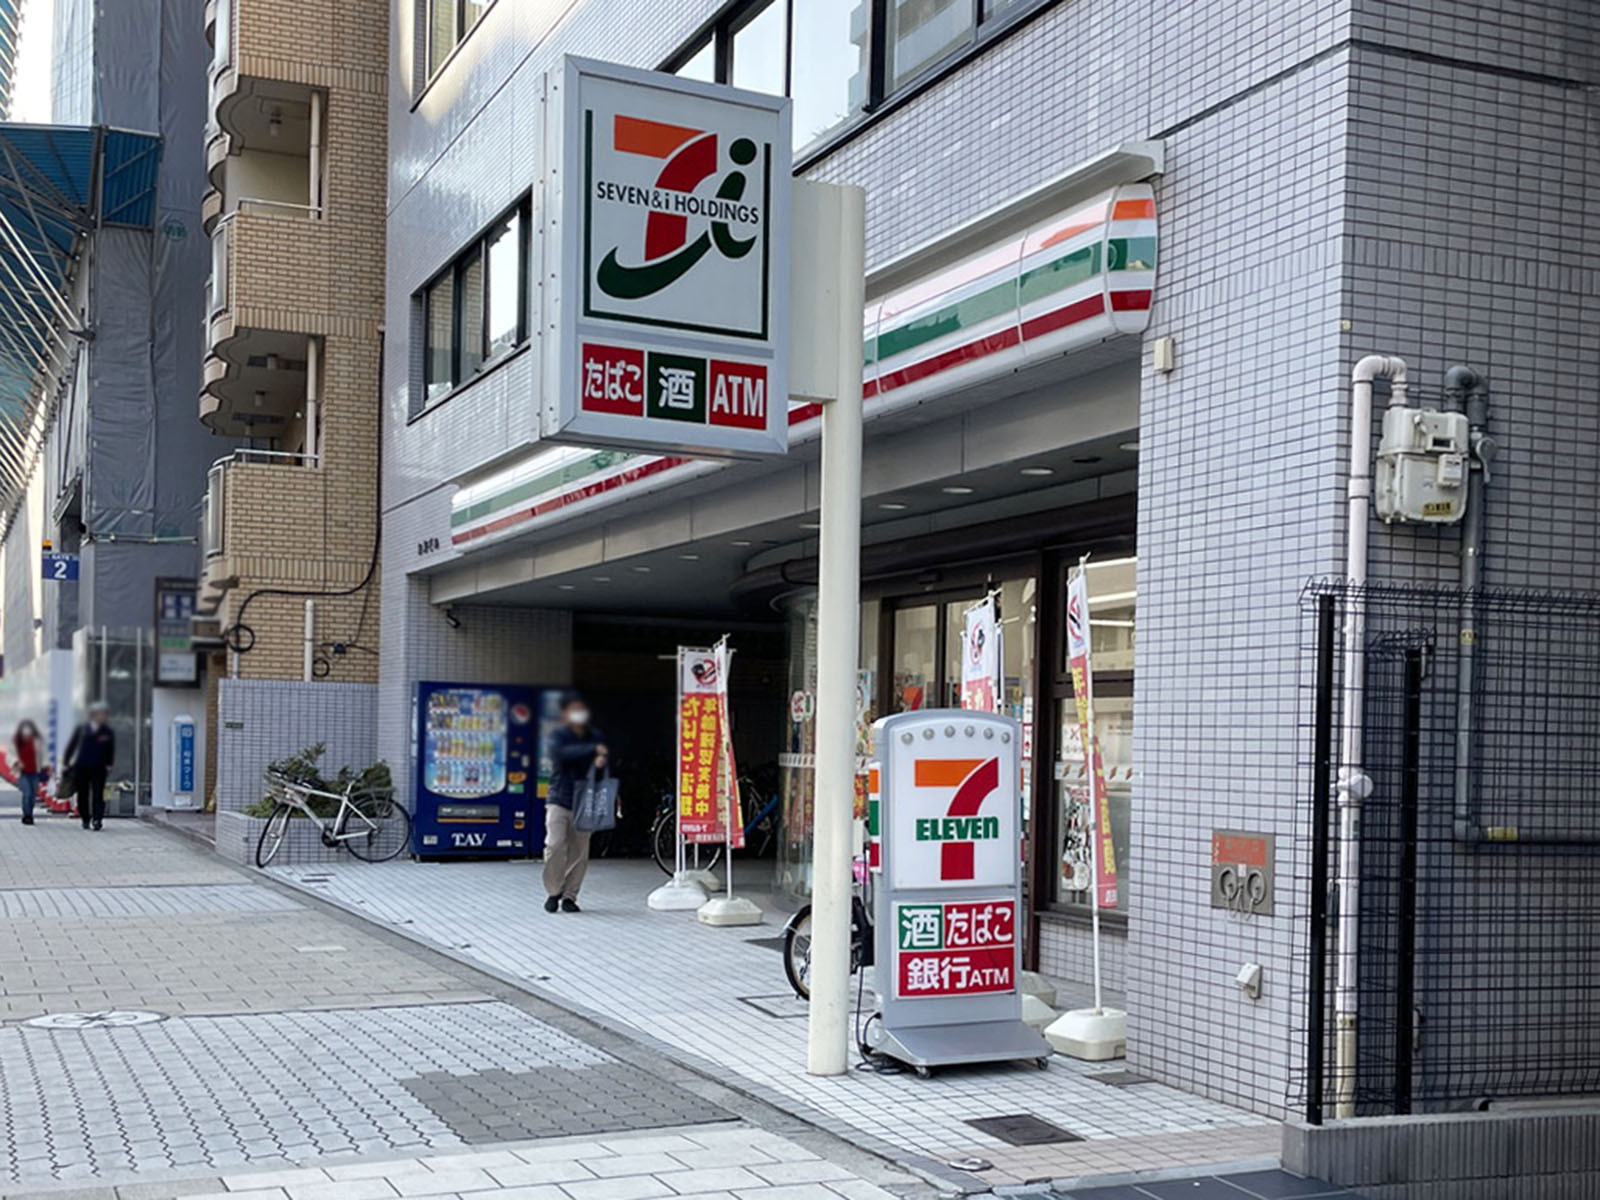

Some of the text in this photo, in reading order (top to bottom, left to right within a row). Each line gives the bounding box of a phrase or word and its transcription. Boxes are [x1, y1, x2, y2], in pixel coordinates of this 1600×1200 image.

[596, 180, 759, 224] SEVEN&i HOLDINGS
[584, 357, 764, 418] たばこ 酒 ATM
[54, 560, 67, 579] 2
[901, 904, 1013, 948] 酒 たばこ
